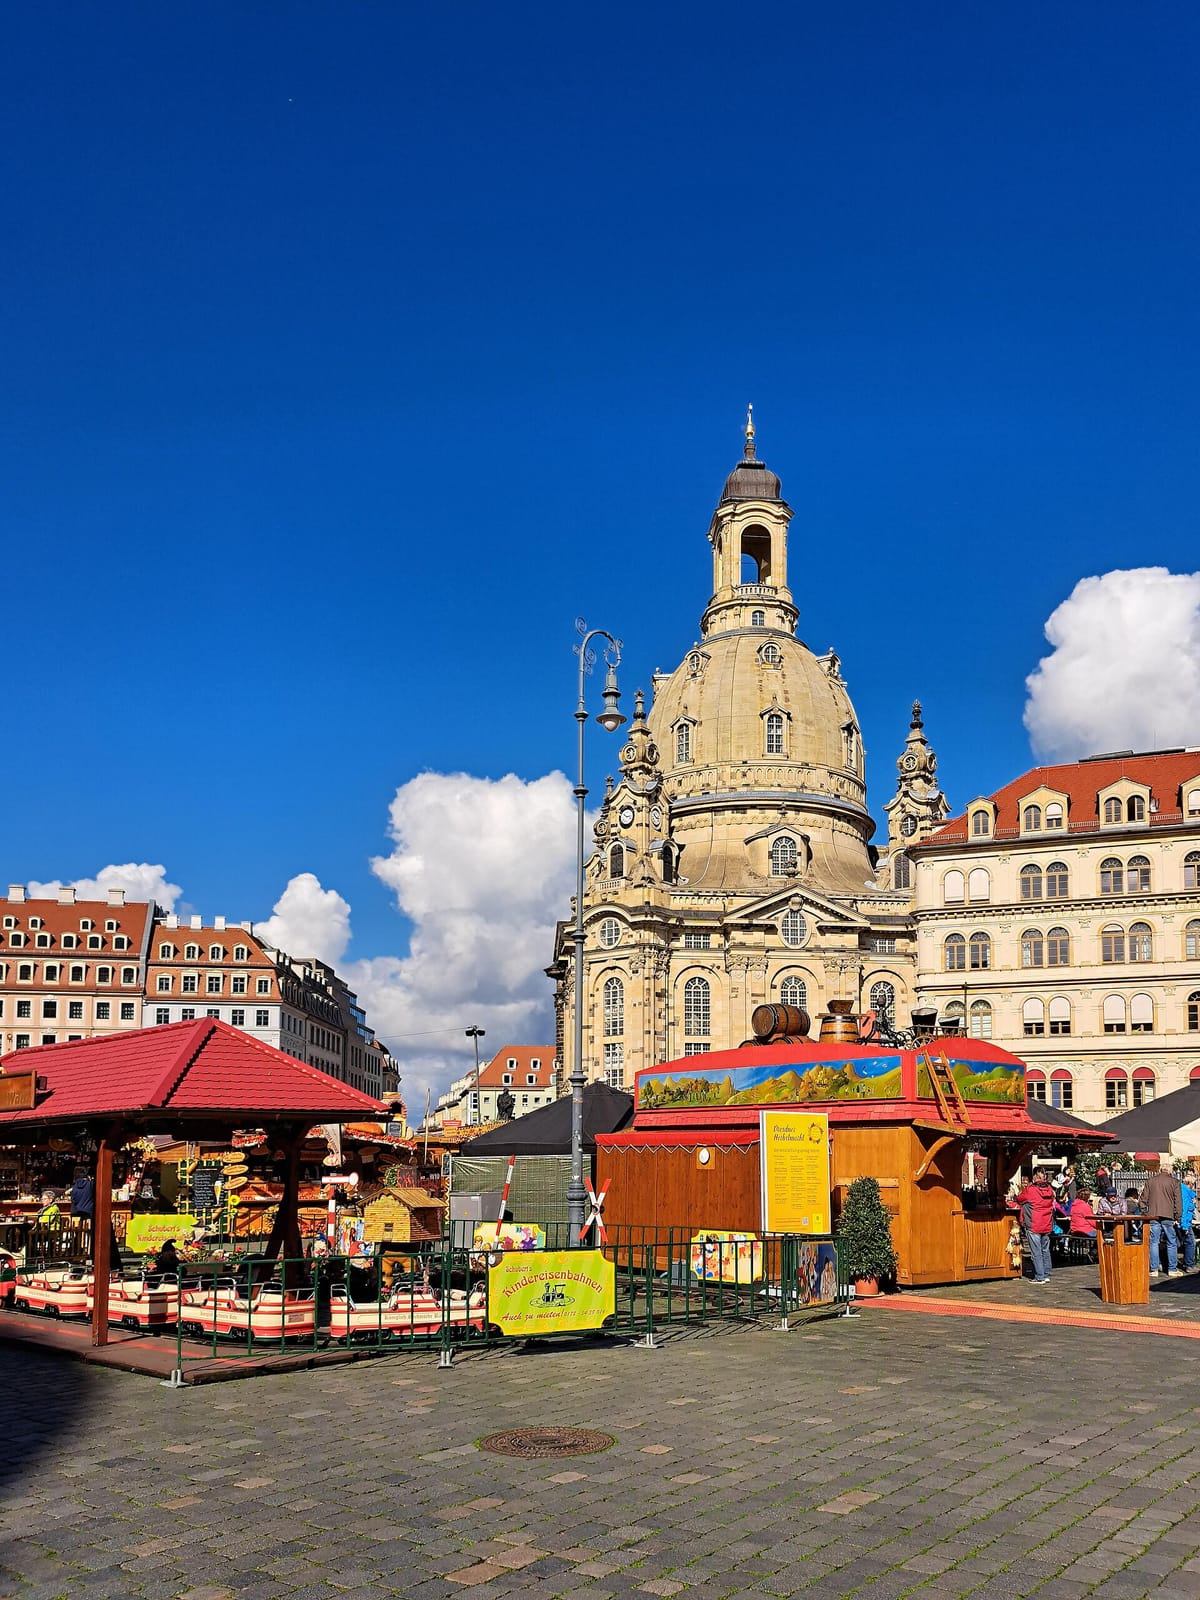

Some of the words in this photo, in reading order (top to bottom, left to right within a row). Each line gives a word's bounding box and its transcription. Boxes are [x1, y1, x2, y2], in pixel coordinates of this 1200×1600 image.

[502, 1269, 604, 1298] Kindereisenbahnen
[501, 1312, 523, 1322] Auch
[524, 1313, 534, 1321] zu
[536, 1310, 561, 1319] mieten
